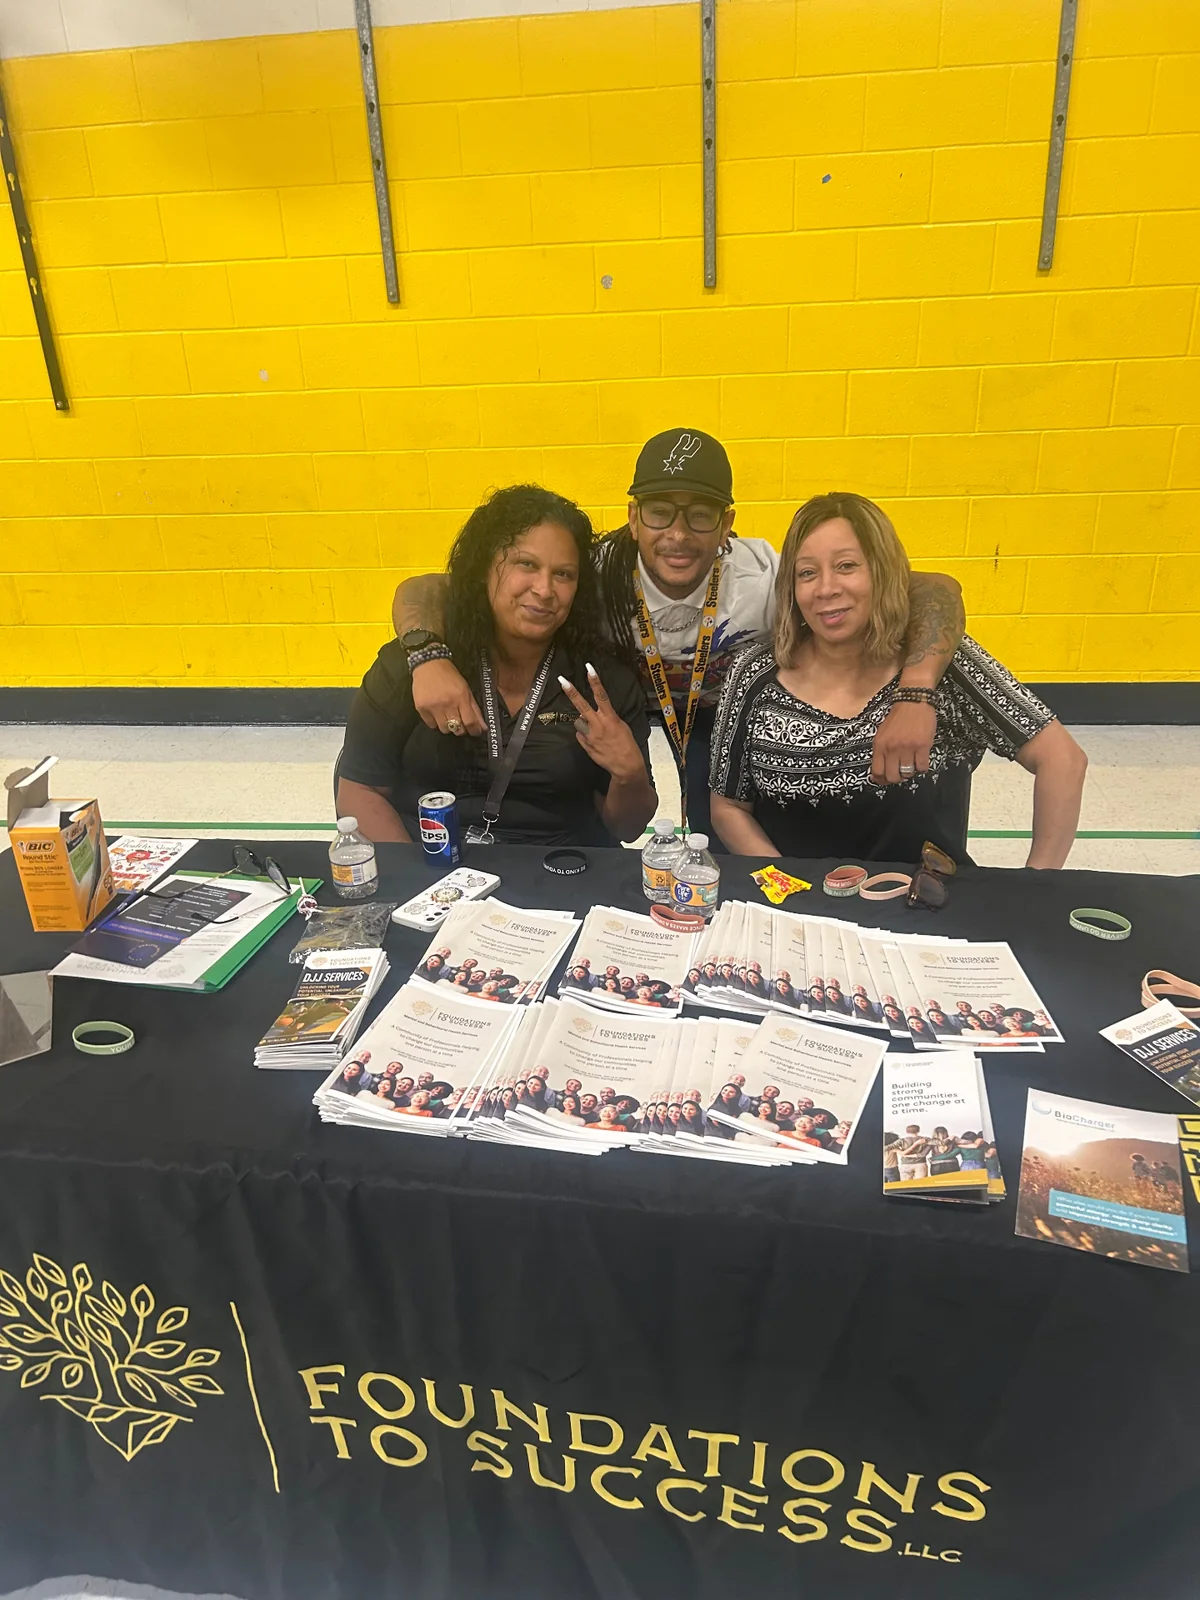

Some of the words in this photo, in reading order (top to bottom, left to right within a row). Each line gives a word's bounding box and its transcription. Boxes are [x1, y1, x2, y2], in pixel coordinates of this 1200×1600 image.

[706, 567, 720, 608] Steelers
[639, 599, 649, 638] Steelers
[694, 635, 710, 673] Steelers
[651, 662, 667, 700] Steelers
[422, 831, 447, 840] EPSI
[677, 884, 690, 892] Pure
[302, 972, 323, 982] DJJ
[324, 971, 364, 982] SERVICES
[438, 1012, 491, 1026] FOUNDATIONS
[449, 1018, 483, 1029] SUCCESS
[1133, 1012, 1172, 1031] FOUNDATIONS
[600, 1029, 656, 1039] FOUNDATIONS
[805, 1038, 864, 1058] FOUNDATIONS
[817, 1046, 855, 1059] SUCCESS
[1133, 1043, 1159, 1059] DJJ
[1152, 1029, 1197, 1050] SERVICES
[892, 1081, 932, 1089] Building
[892, 1092, 958, 1101] communities
[1054, 1110, 1116, 1129] BioCharger
[298, 1364, 990, 1522] FOUNDATIONS
[308, 1414, 428, 1468] TO
